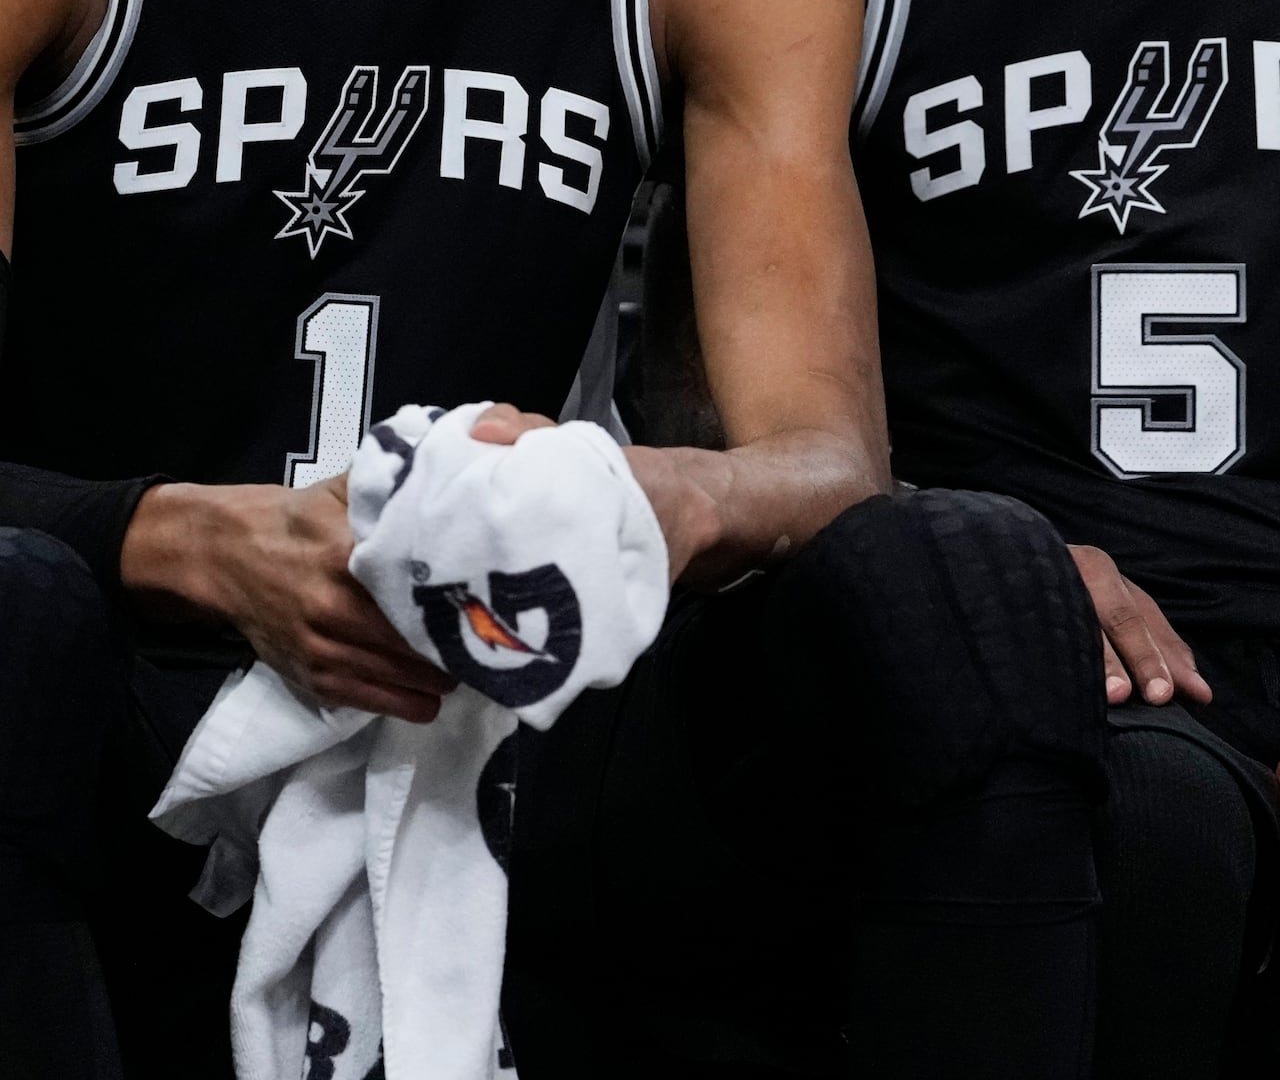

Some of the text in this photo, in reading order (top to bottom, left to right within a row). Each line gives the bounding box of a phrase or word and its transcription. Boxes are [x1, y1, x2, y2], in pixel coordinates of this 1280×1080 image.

[113, 65, 610, 260] SPURS
[283, 292, 381, 489] 1
[1091, 263, 1246, 480] 5
